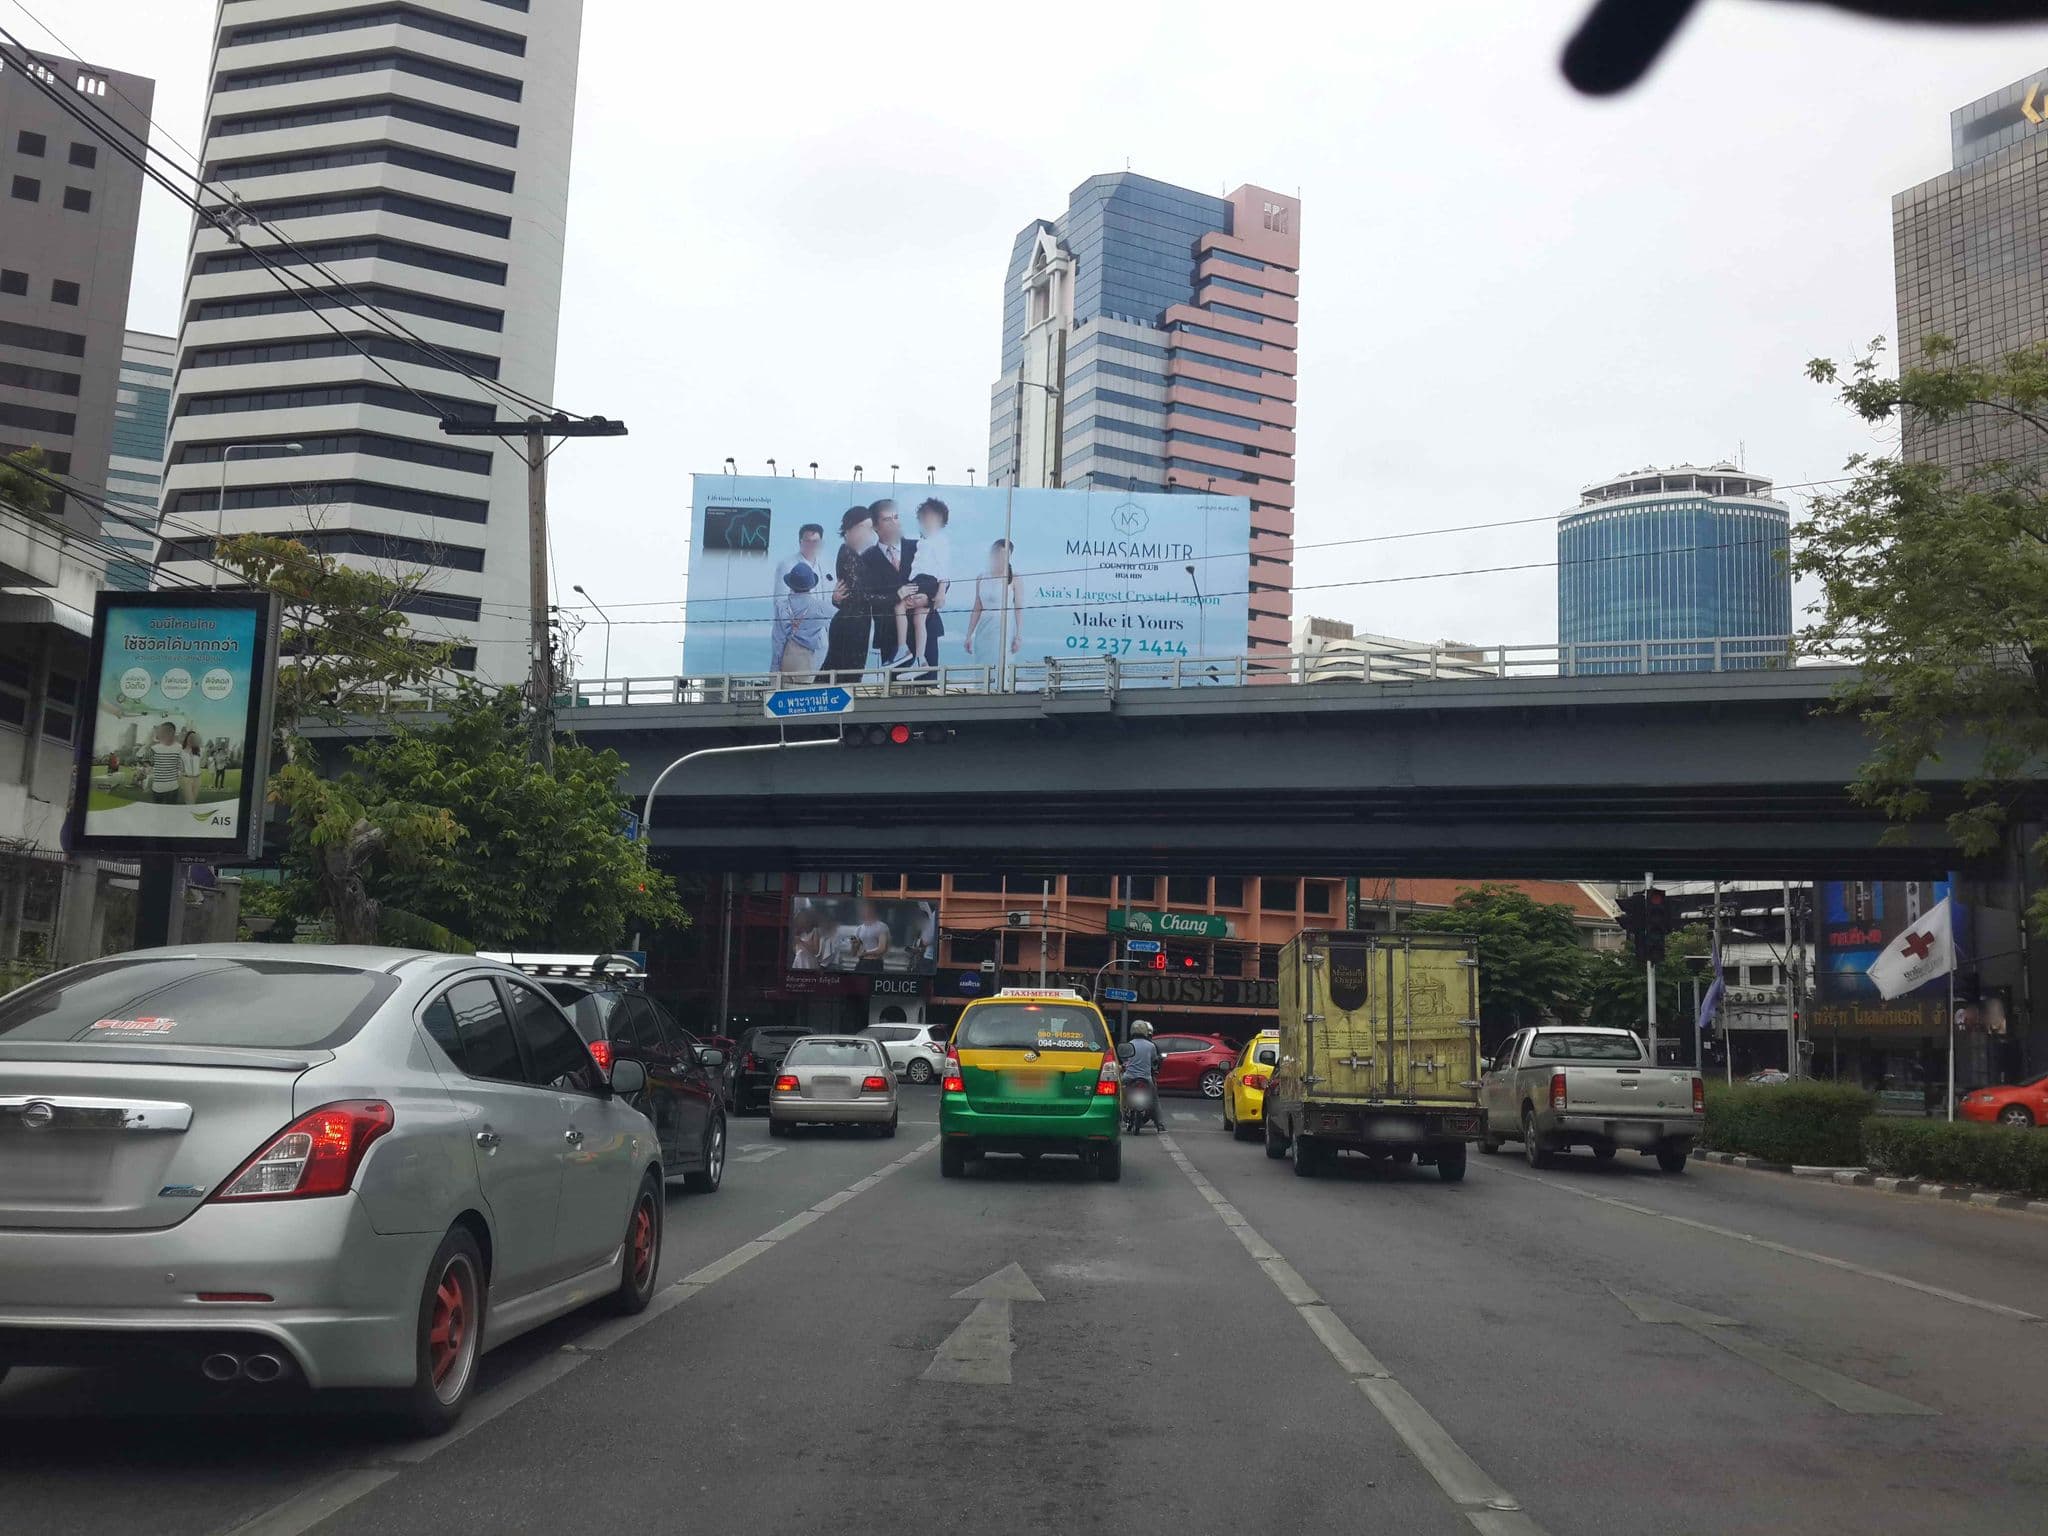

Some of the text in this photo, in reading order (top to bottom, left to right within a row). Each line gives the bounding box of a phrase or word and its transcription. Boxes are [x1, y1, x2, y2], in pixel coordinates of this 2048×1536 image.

[1066, 539, 1193, 560] MAHASAMUTR
[1100, 562, 1159, 572] COUNTRY CLUB
[1035, 586, 1220, 608] Asia's Largest Crystal Lagoon
[1072, 611, 1184, 630] Make it Yours
[124, 634, 239, 651] ใช้ชีวิตได้มากกว่า
[1066, 635, 1188, 657] 02 237 1414
[210, 816, 231, 826] AIS
[1160, 913, 1208, 935] Chang
[874, 979, 917, 993] POLICE
